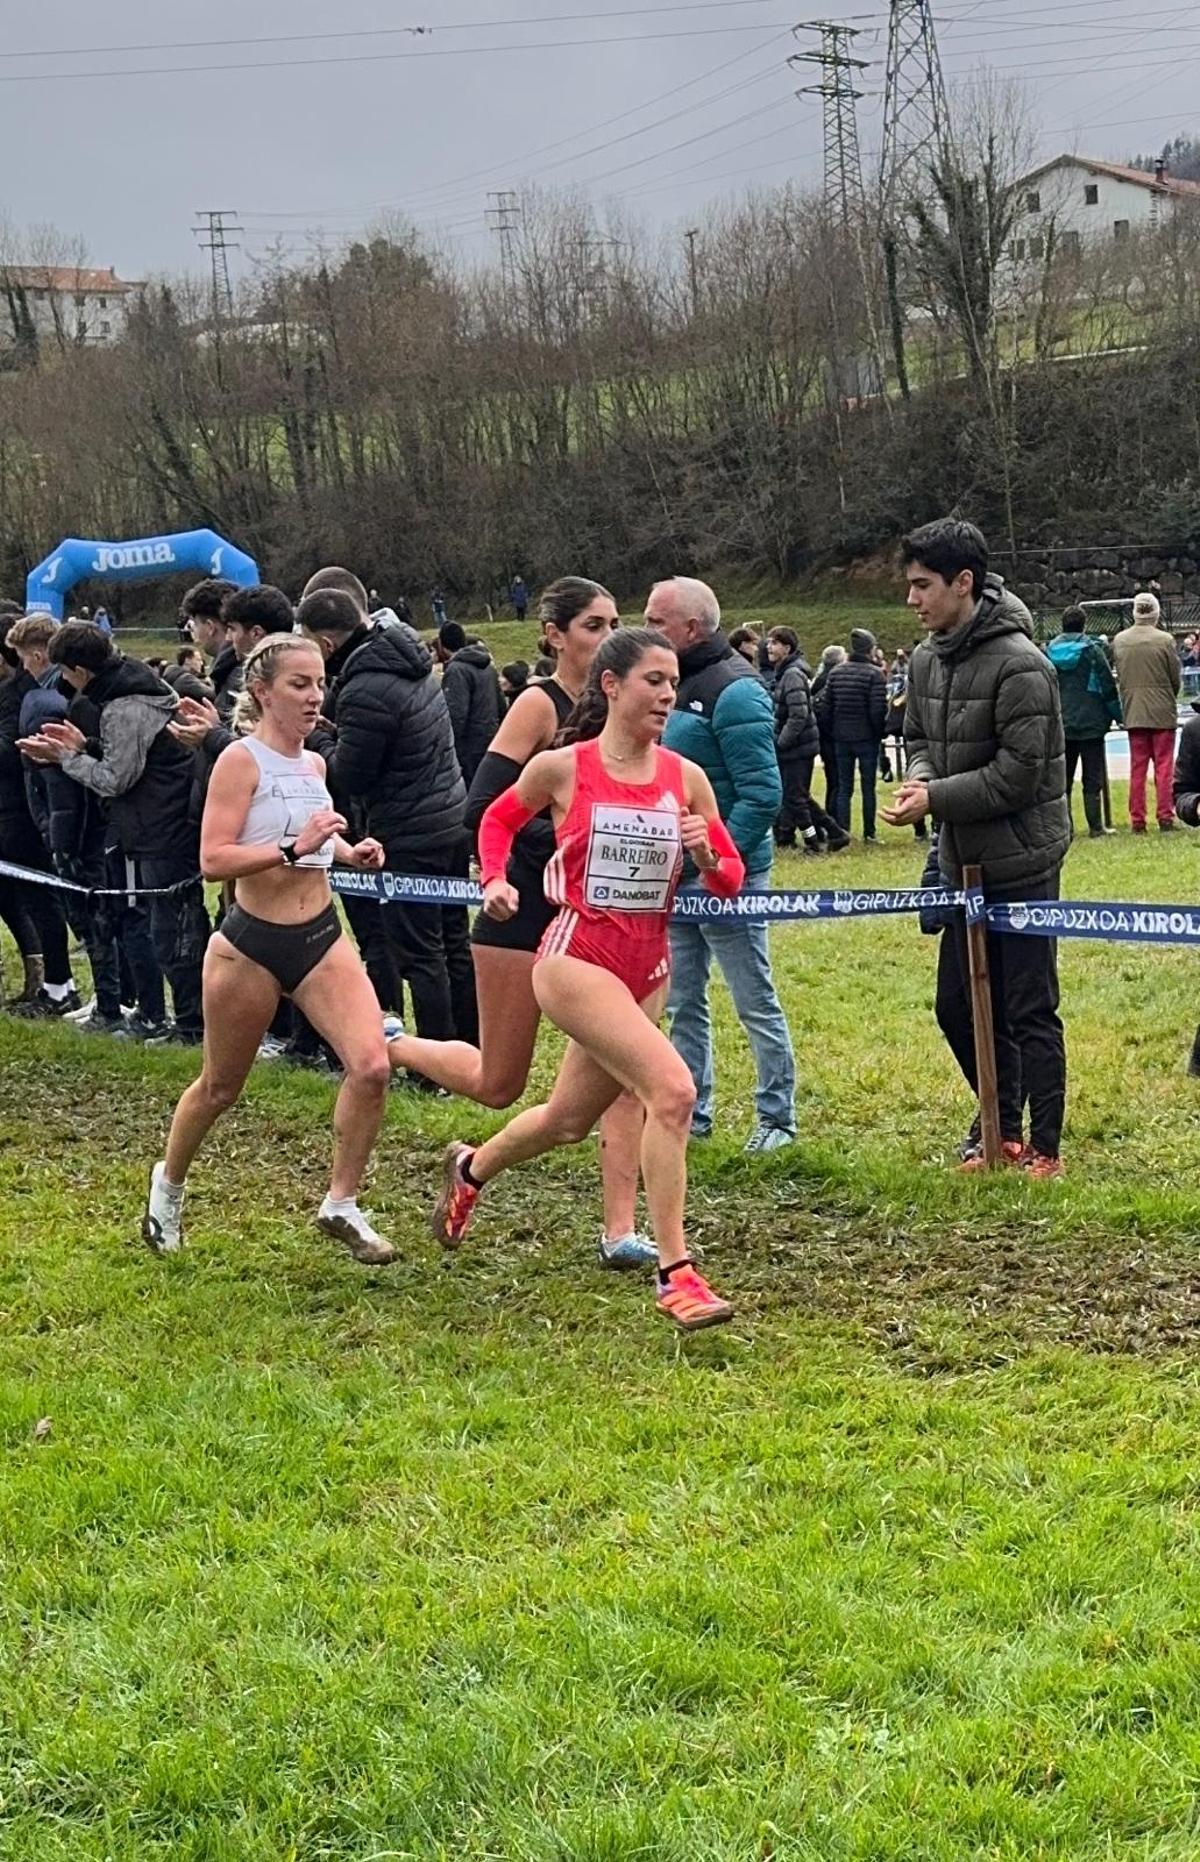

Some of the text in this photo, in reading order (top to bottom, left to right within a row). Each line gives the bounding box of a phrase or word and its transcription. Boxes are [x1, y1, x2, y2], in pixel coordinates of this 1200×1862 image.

[603, 822, 673, 836] AMENABAR
[601, 844, 668, 866] BARREIRO
[628, 866, 640, 878] 7
[612, 889, 661, 901] DANOBAT
[737, 894, 820, 915] KIROLAK
[853, 891, 949, 911] GIPUZKOA
[1030, 907, 1200, 935] GIPUZKOA KIROL
